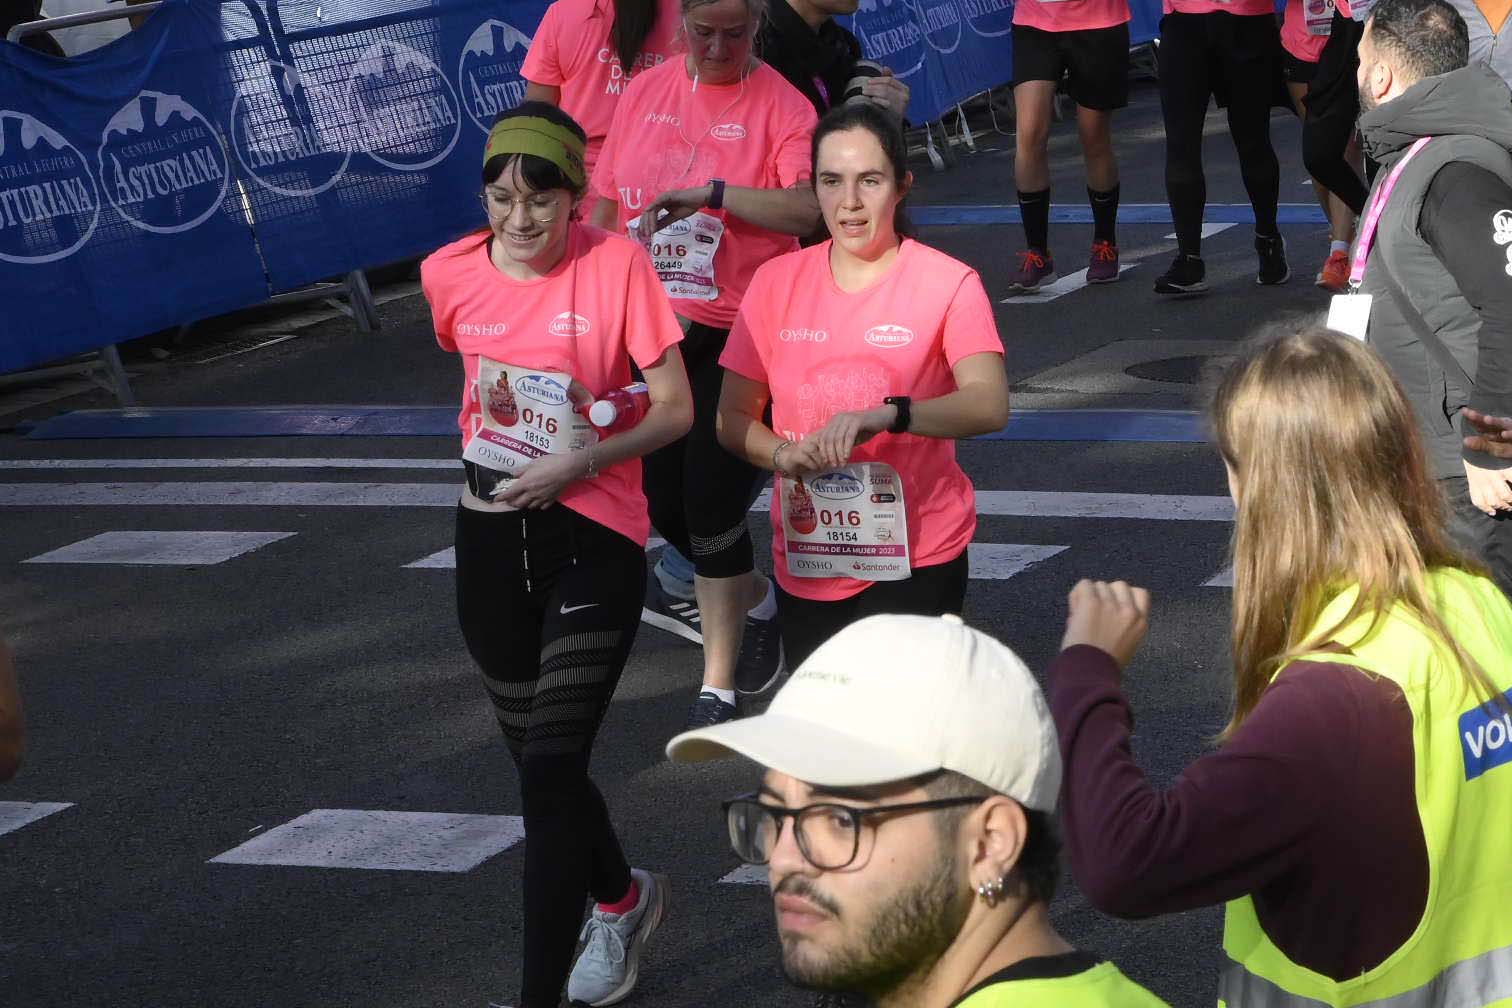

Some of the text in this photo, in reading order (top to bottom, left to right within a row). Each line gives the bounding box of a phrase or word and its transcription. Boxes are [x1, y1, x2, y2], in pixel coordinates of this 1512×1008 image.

[598, 48, 665, 67] CARER
[110, 145, 224, 206] ASTURIANA
[0, 176, 94, 230] TURIANA
[619, 186, 642, 209] TU
[653, 243, 687, 257] 016
[456, 323, 506, 337] OYSHO
[780, 328, 827, 343] OYSHO
[519, 380, 565, 403] ASTURIANA
[522, 407, 558, 434] 016
[524, 430, 551, 450] 18153
[478, 446, 516, 468] OYSHO
[815, 482, 861, 494] ASTURIANA
[819, 509, 861, 527] 016
[826, 531, 858, 542] 18154
[798, 544, 830, 553] CARRERA
[842, 546, 852, 554] LA
[852, 547, 877, 555] MUJER
[796, 560, 900, 573] OYSHO Santander
